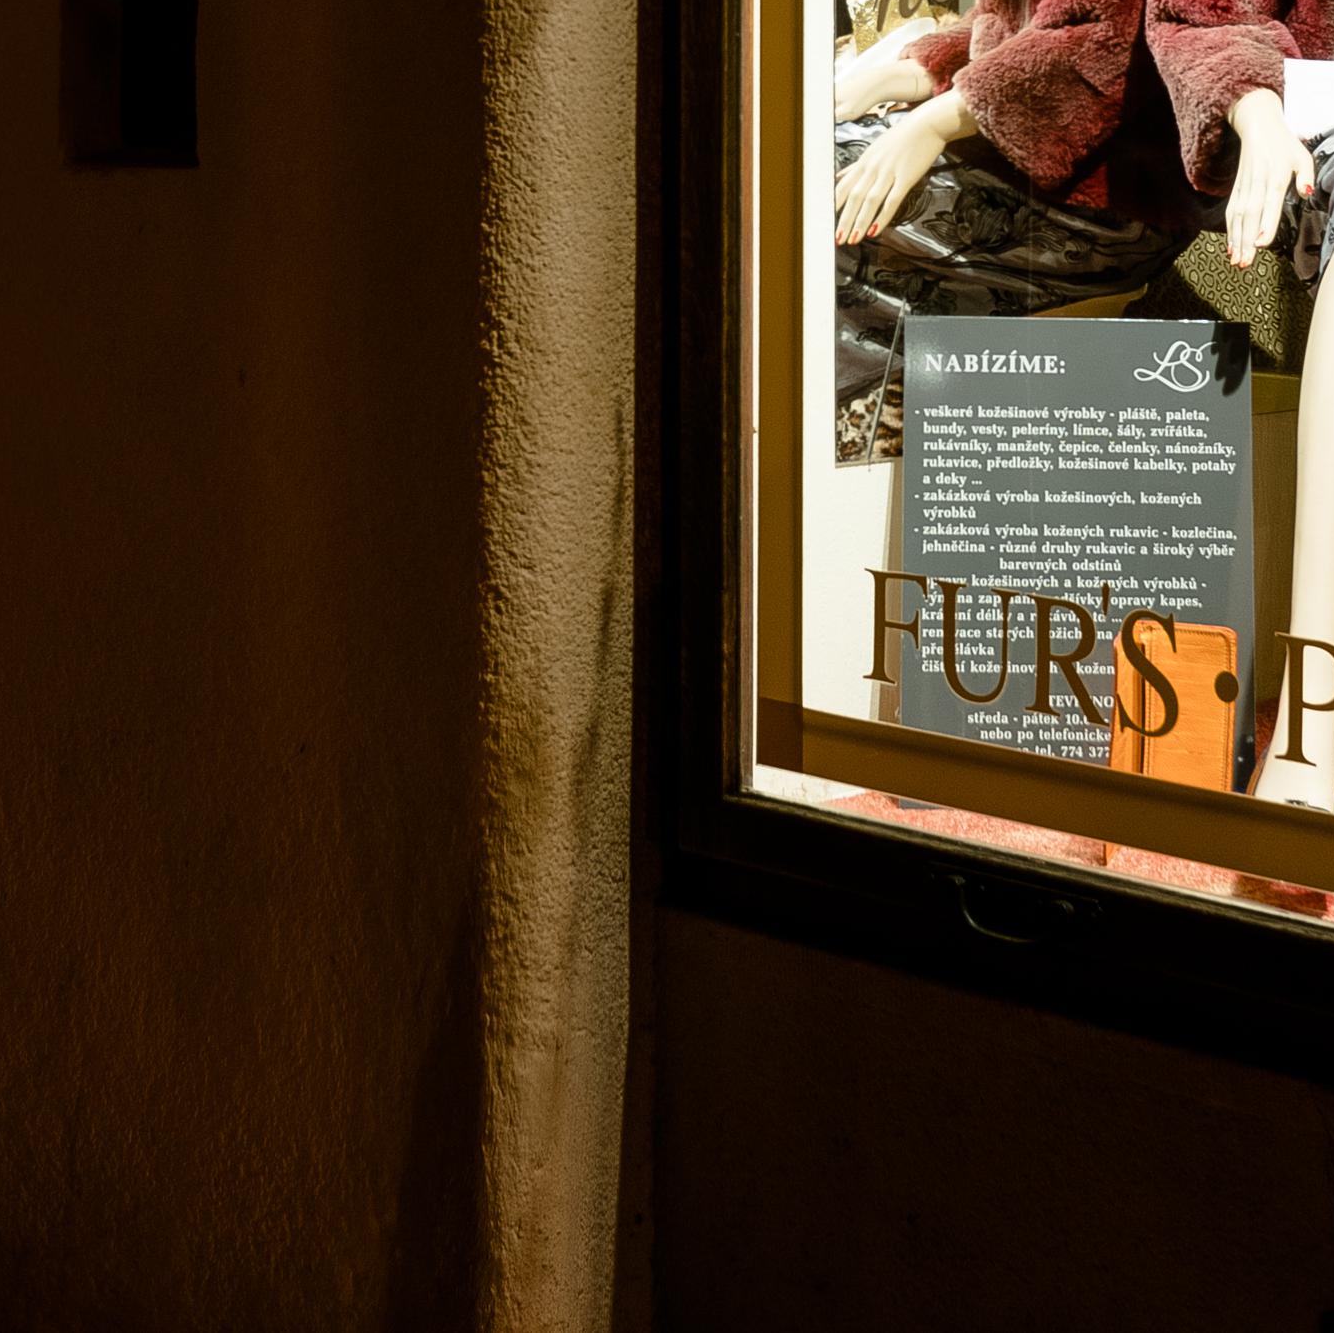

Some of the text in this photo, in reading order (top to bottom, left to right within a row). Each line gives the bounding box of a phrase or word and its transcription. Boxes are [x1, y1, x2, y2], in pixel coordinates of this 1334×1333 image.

[924, 349, 1066, 374] NABÍZÍME:
[923, 404, 973, 418] veškeré
[977, 405, 1049, 418] kožešinové
[1053, 406, 1106, 422] výrobky
[1118, 407, 1161, 423] pláště,
[1165, 408, 1210, 424] paleta,
[923, 421, 1207, 440] bundy, vesty, peleríny, límce, šály, zvířátka,
[923, 438, 1236, 458] rukávníky, manžety, čepice, čelenky, nánožníky,
[923, 455, 1236, 475] rukavice, předložky, kožešinové kabelky, potahy
[922, 475, 931, 485] a
[935, 472, 967, 488] deky
[923, 489, 991, 502] zakázková
[995, 490, 1040, 505] výroba
[1044, 490, 1136, 507] kožešinových,
[1140, 492, 1202, 508] kožených
[923, 506, 976, 521] výrobků
[922, 523, 990, 536] zakázková
[995, 524, 1038, 539] výroba
[1043, 524, 1104, 540] kožených
[1109, 525, 1159, 538] rukavic
[1171, 526, 1238, 540] kozlečina,
[922, 539, 985, 554] jehněčina
[999, 541, 1037, 553] různé
[1041, 541, 1081, 557] druhy
[1085, 542, 1136, 555] rukavic
[1140, 545, 1148, 555] a
[1153, 542, 1195, 559] široký
[1198, 544, 1236, 559] výběr
[999, 557, 1122, 573] barevných odstínů
[971, 574, 1059, 591] kožešinových
[1063, 578, 1071, 588] a
[1143, 577, 1197, 592] výrobků
[1110, 595, 1155, 609] opravy
[1160, 594, 1202, 610] kapes,
[1017, 612, 1025, 621] a
[967, 711, 1009, 724] středa
[980, 727, 1012, 740] nebo
[1017, 730, 1034, 743] po
[1060, 745, 1083, 758] 774
